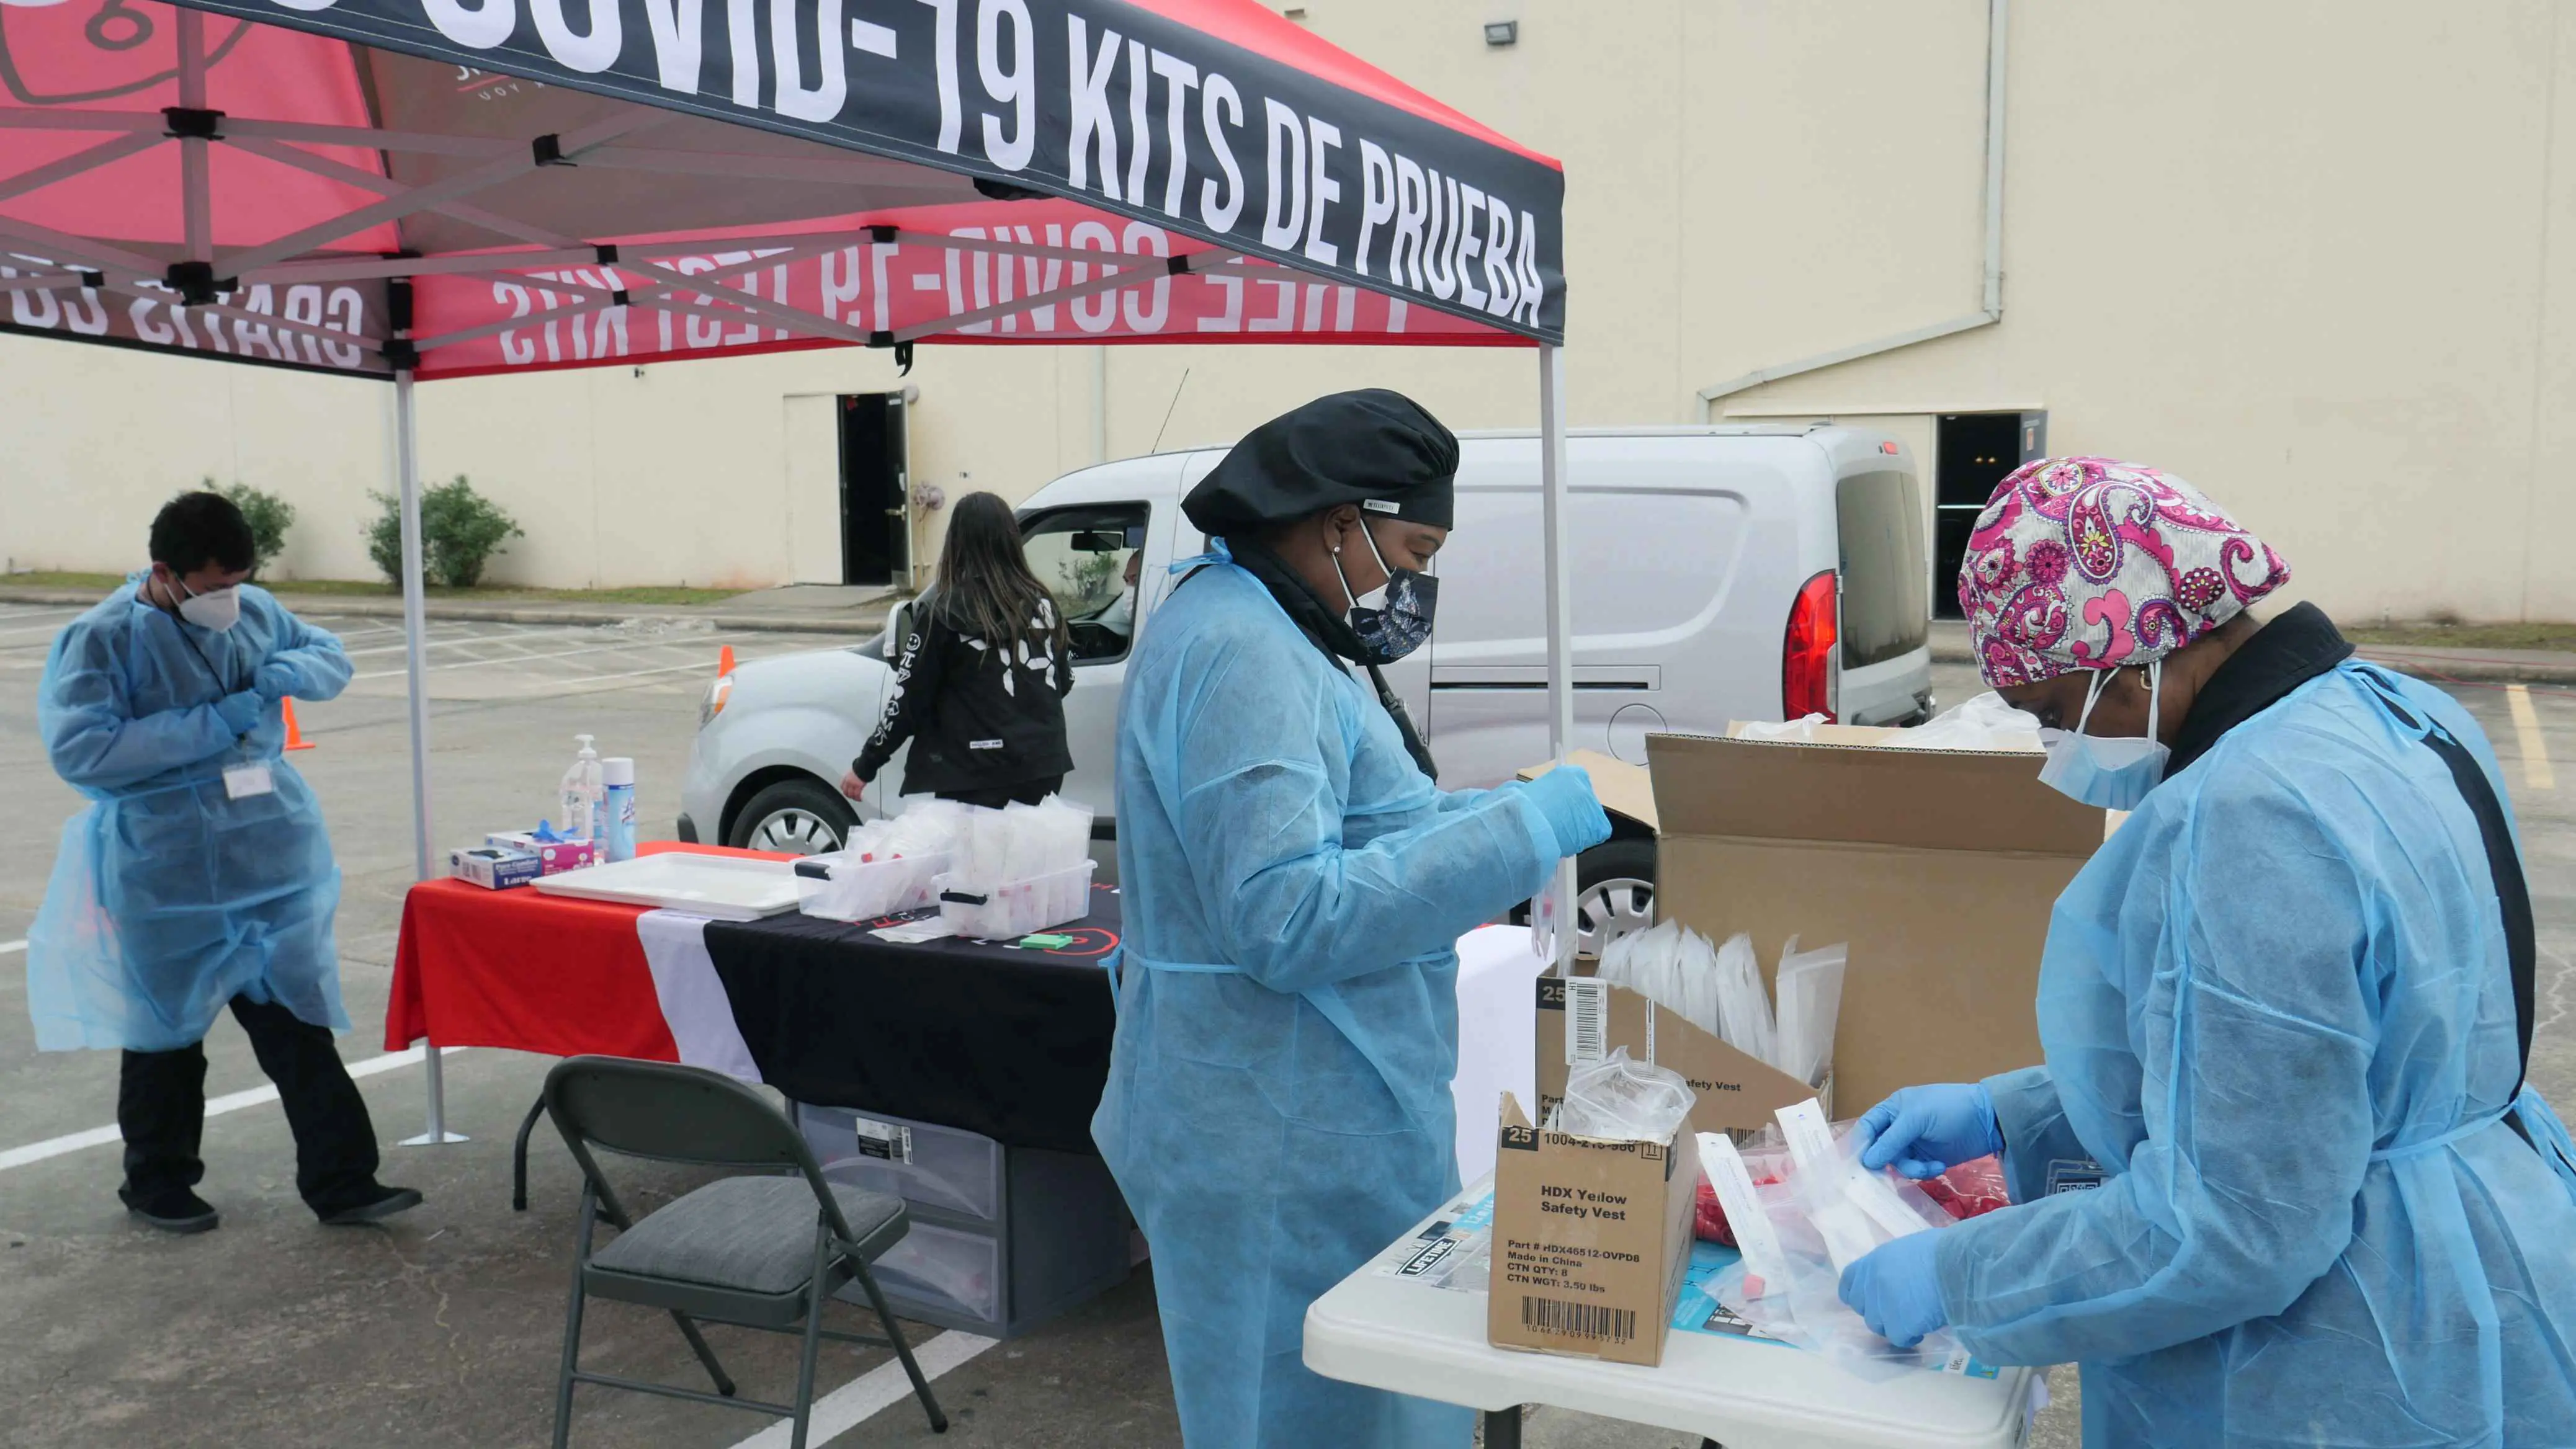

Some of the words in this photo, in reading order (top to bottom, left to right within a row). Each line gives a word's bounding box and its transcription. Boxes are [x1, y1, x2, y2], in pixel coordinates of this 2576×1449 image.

[421, 0, 1036, 172] VID-19
[1067, 12, 1243, 234] KITS
[1261, 96, 1342, 267] DE
[1356, 138, 1544, 329] PRUEBA
[1542, 986, 1565, 1002] 25
[1686, 1079, 1712, 1091] afety
[1715, 1081, 1742, 1092] Vest
[1542, 1094, 1564, 1104] Part
[1509, 1128, 1532, 1143] 25
[1541, 1185, 1572, 1198] HDX
[1577, 1190, 1627, 1205] Yellow
[1541, 1202, 1588, 1218] Safety
[1592, 1207, 1626, 1221] Vest
[1508, 1240, 1530, 1250] Part
[1407, 1241, 1453, 1272] LIFETIME
[1508, 1251, 1536, 1262] Made
[1539, 1254, 1549, 1263] in
[1552, 1257, 1583, 1267] China
[1507, 1262, 1529, 1272] CTN
[1533, 1265, 1558, 1275] QTY:
[1507, 1273, 1529, 1283] CTN
[1533, 1277, 1560, 1287] WGT:
[1563, 1280, 1586, 1290] 3.50
[1590, 1283, 1606, 1293] lbs
